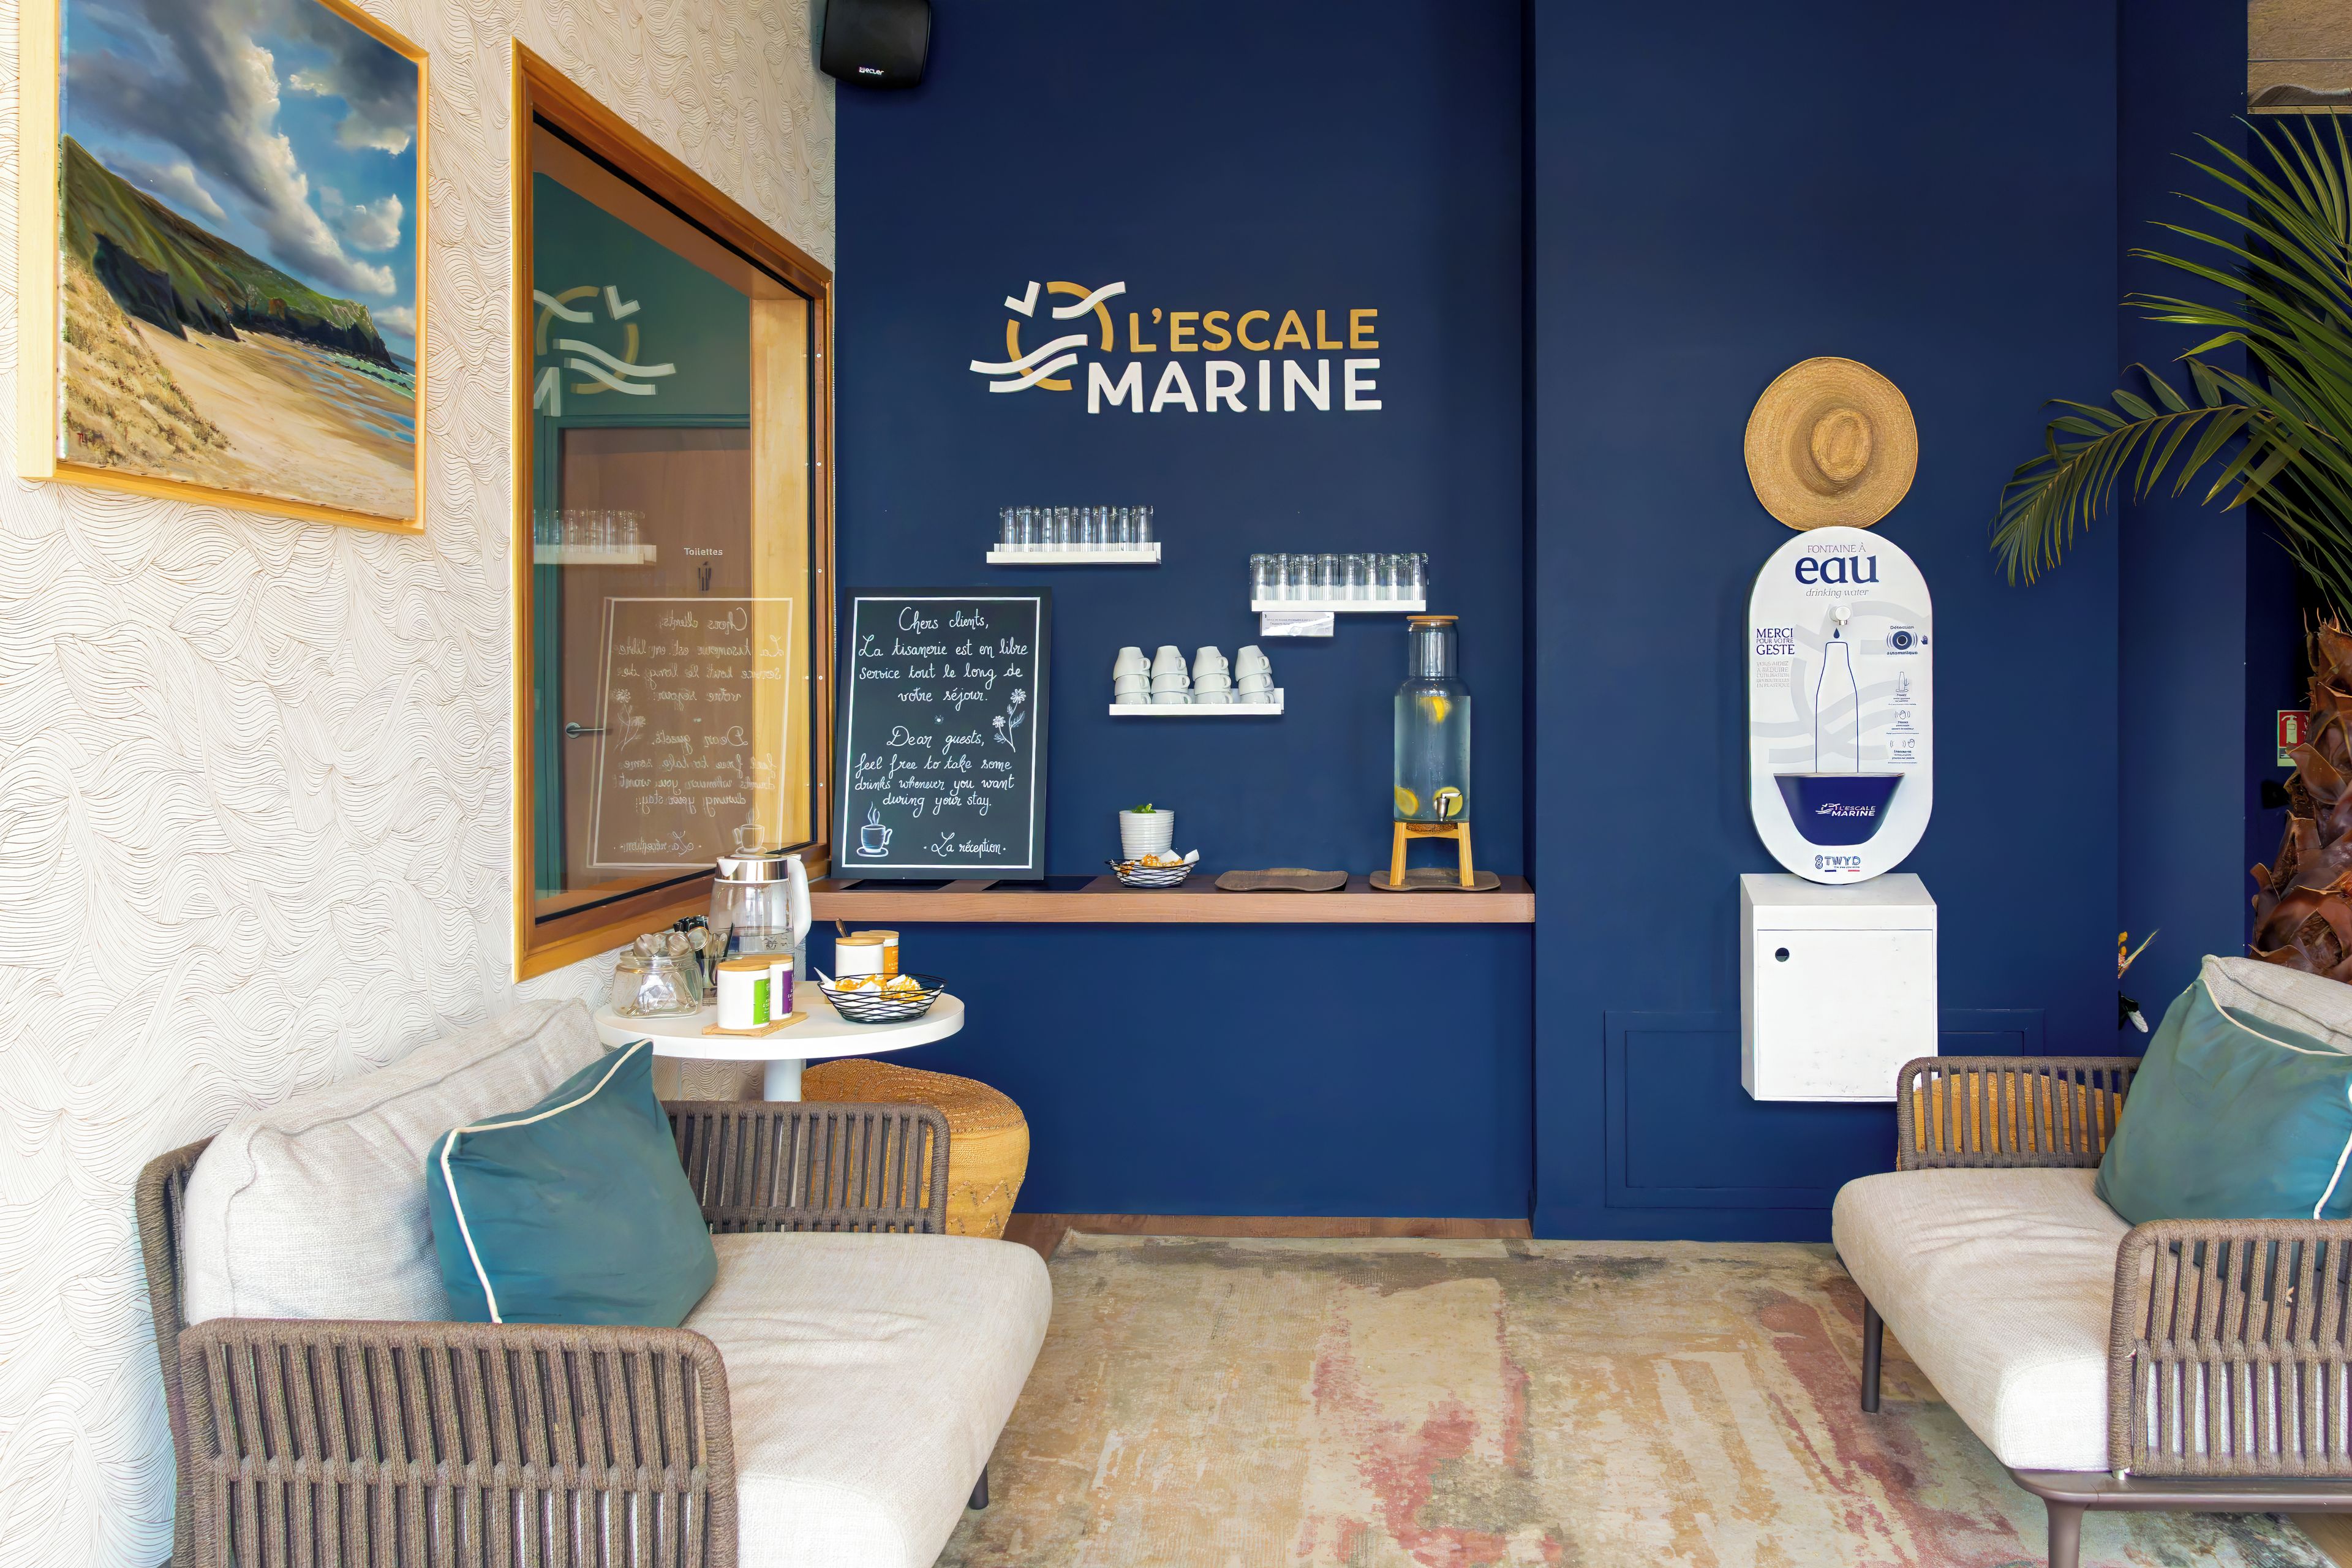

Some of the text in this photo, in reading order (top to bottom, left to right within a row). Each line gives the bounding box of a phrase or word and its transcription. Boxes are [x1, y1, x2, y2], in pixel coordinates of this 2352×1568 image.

[1129, 308, 1379, 353] L'ESCALE
[1088, 358, 1382, 413] MARINE
[1807, 542, 1866, 553] FONTAINE À
[1795, 556, 1879, 584] eau
[1806, 589, 1842, 598] drinking
[899, 607, 989, 634] Chers clients,
[1757, 628, 1793, 638] MERCI
[859, 635, 1028, 658] La tisanerie est en libre
[1757, 644, 1795, 655] GESTE
[908, 663, 935, 679] tout
[943, 664, 956, 678] le
[963, 663, 997, 690] long
[1003, 663, 1023, 677] de
[897, 687, 987, 711] votre séjour.
[887, 726, 984, 755] Dear guests,
[854, 753, 1012, 778] feel free to take some
[855, 774, 1014, 796] drinks whenever you want
[883, 791, 991, 818] during your stay.
[931, 832, 954, 857] La
[1825, 856, 1861, 865] TWYD
